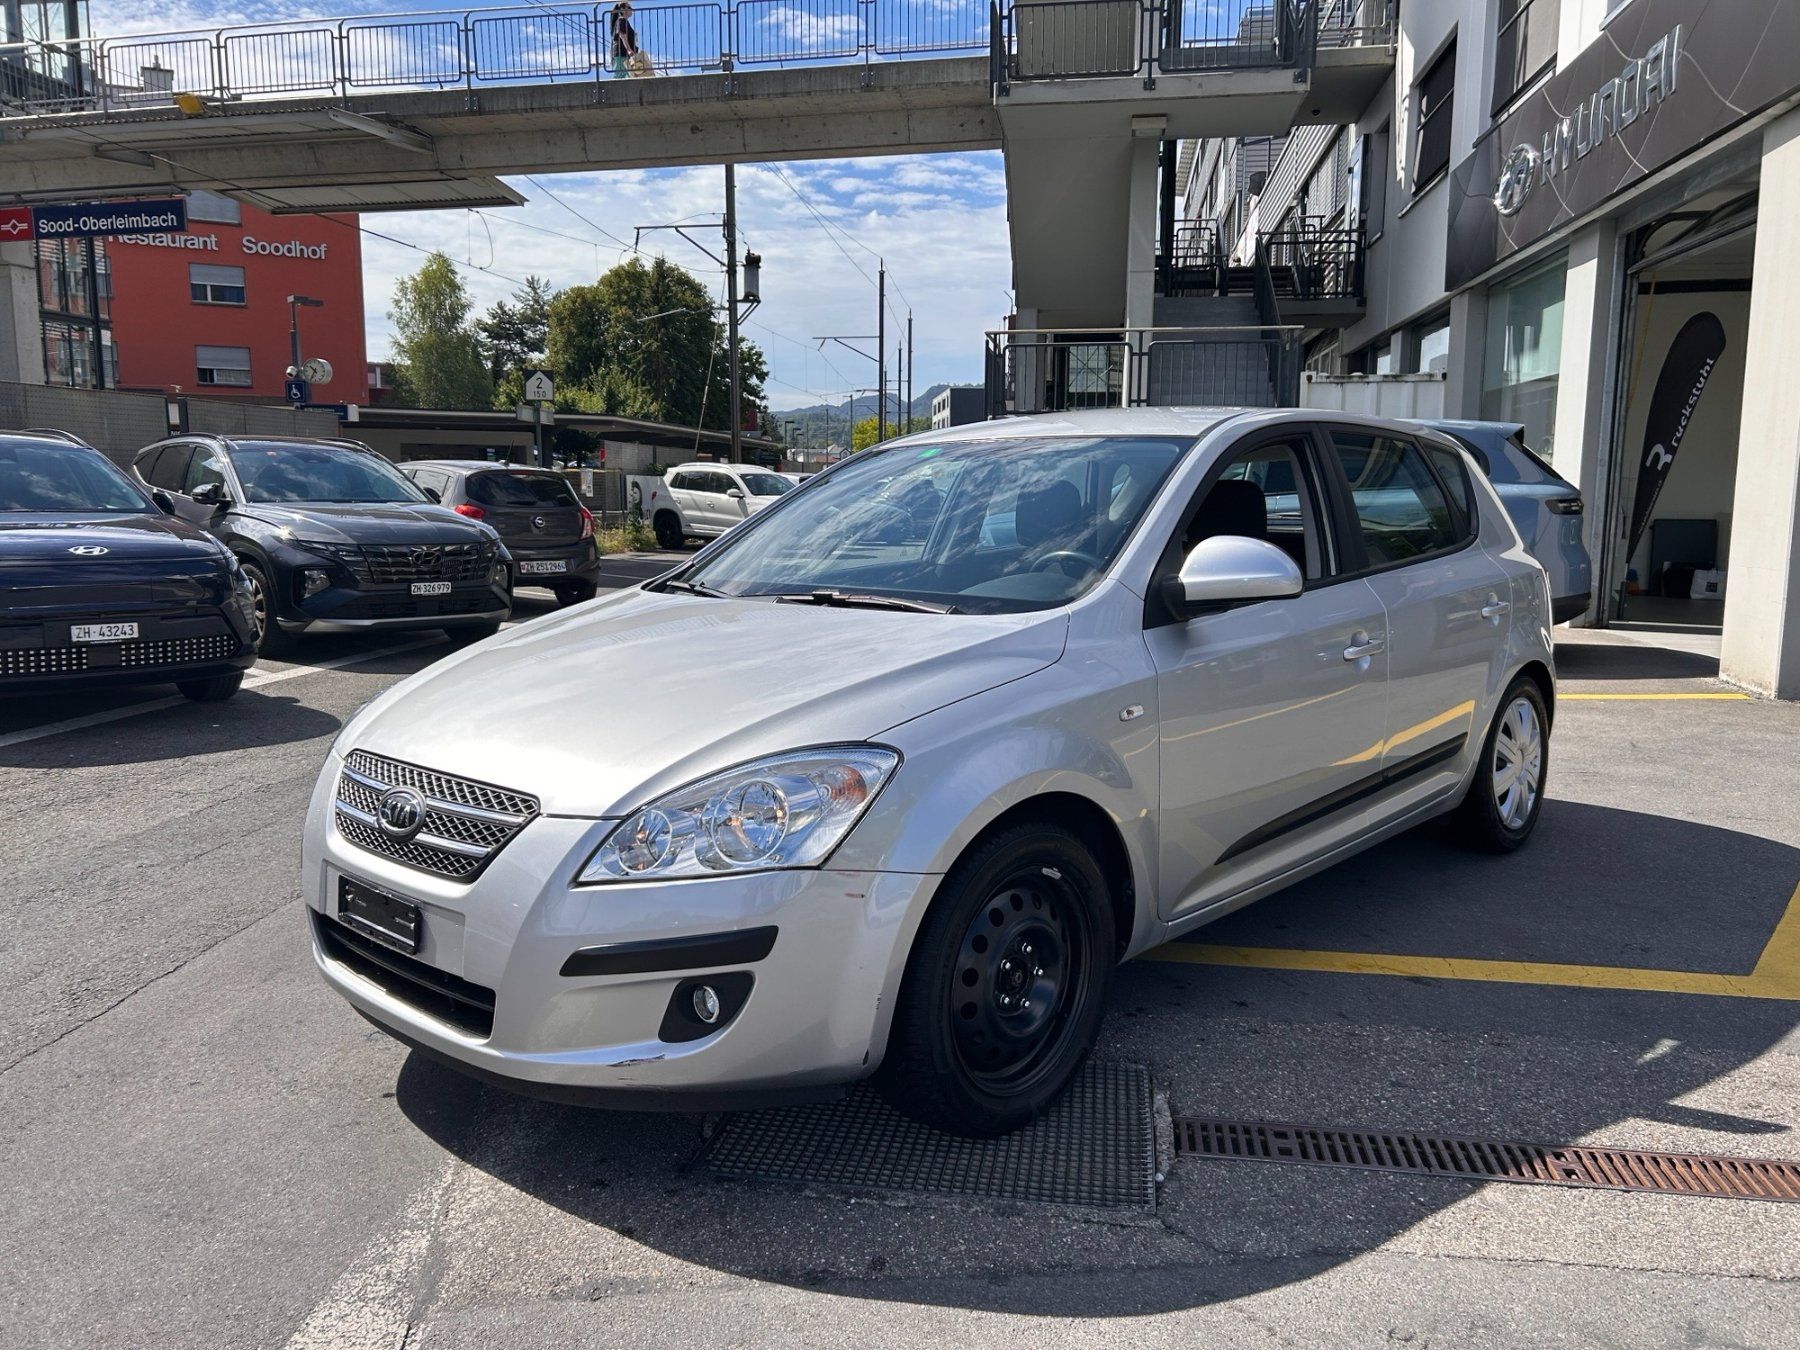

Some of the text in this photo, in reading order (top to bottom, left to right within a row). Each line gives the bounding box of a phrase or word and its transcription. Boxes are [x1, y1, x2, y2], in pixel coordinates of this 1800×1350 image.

[1539, 23, 1682, 186] HYUNDAI
[38, 212, 177, 233] Sood-Oberleimbach
[242, 236, 327, 260] Soodhof
[533, 390, 547, 398] 150
[536, 377, 543, 389] 2
[1671, 358, 1714, 447] ruckstuhl
